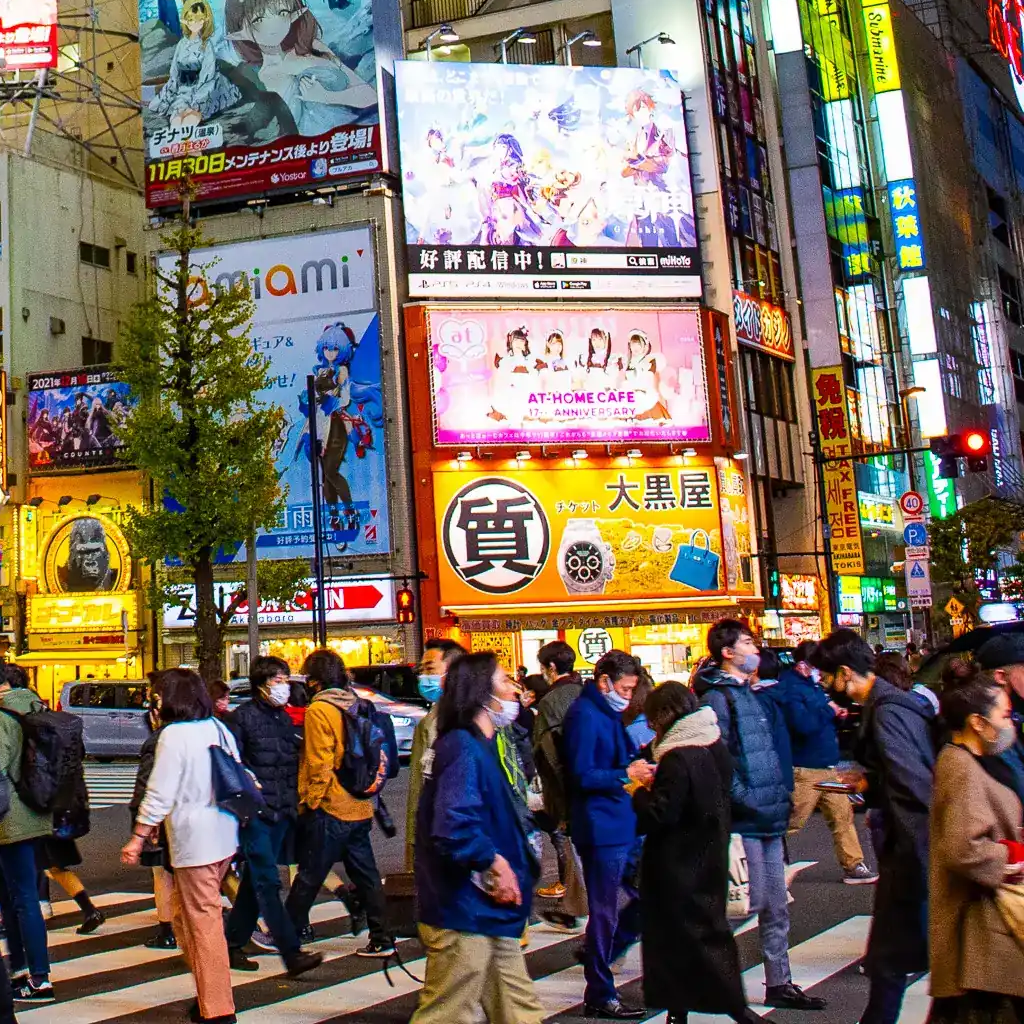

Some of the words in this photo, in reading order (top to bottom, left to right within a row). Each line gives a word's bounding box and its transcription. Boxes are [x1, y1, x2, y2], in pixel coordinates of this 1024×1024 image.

[867, 11, 887, 84] Submarine
[278, 170, 308, 183] Yostar
[186, 255, 351, 308] amiami
[527, 391, 595, 404] AT-HOME
[596, 390, 636, 404] CAFE
[554, 407, 637, 417] ANNIVERSARY
[814, 373, 846, 439] 免税
[835, 444, 852, 483] TAX
[555, 500, 601, 514] チケット
[606, 472, 714, 511] 大黒屋
[905, 497, 919, 509] 40
[841, 488, 859, 538] FREE
[459, 495, 541, 583] 質
[581, 630, 609, 657] 質
